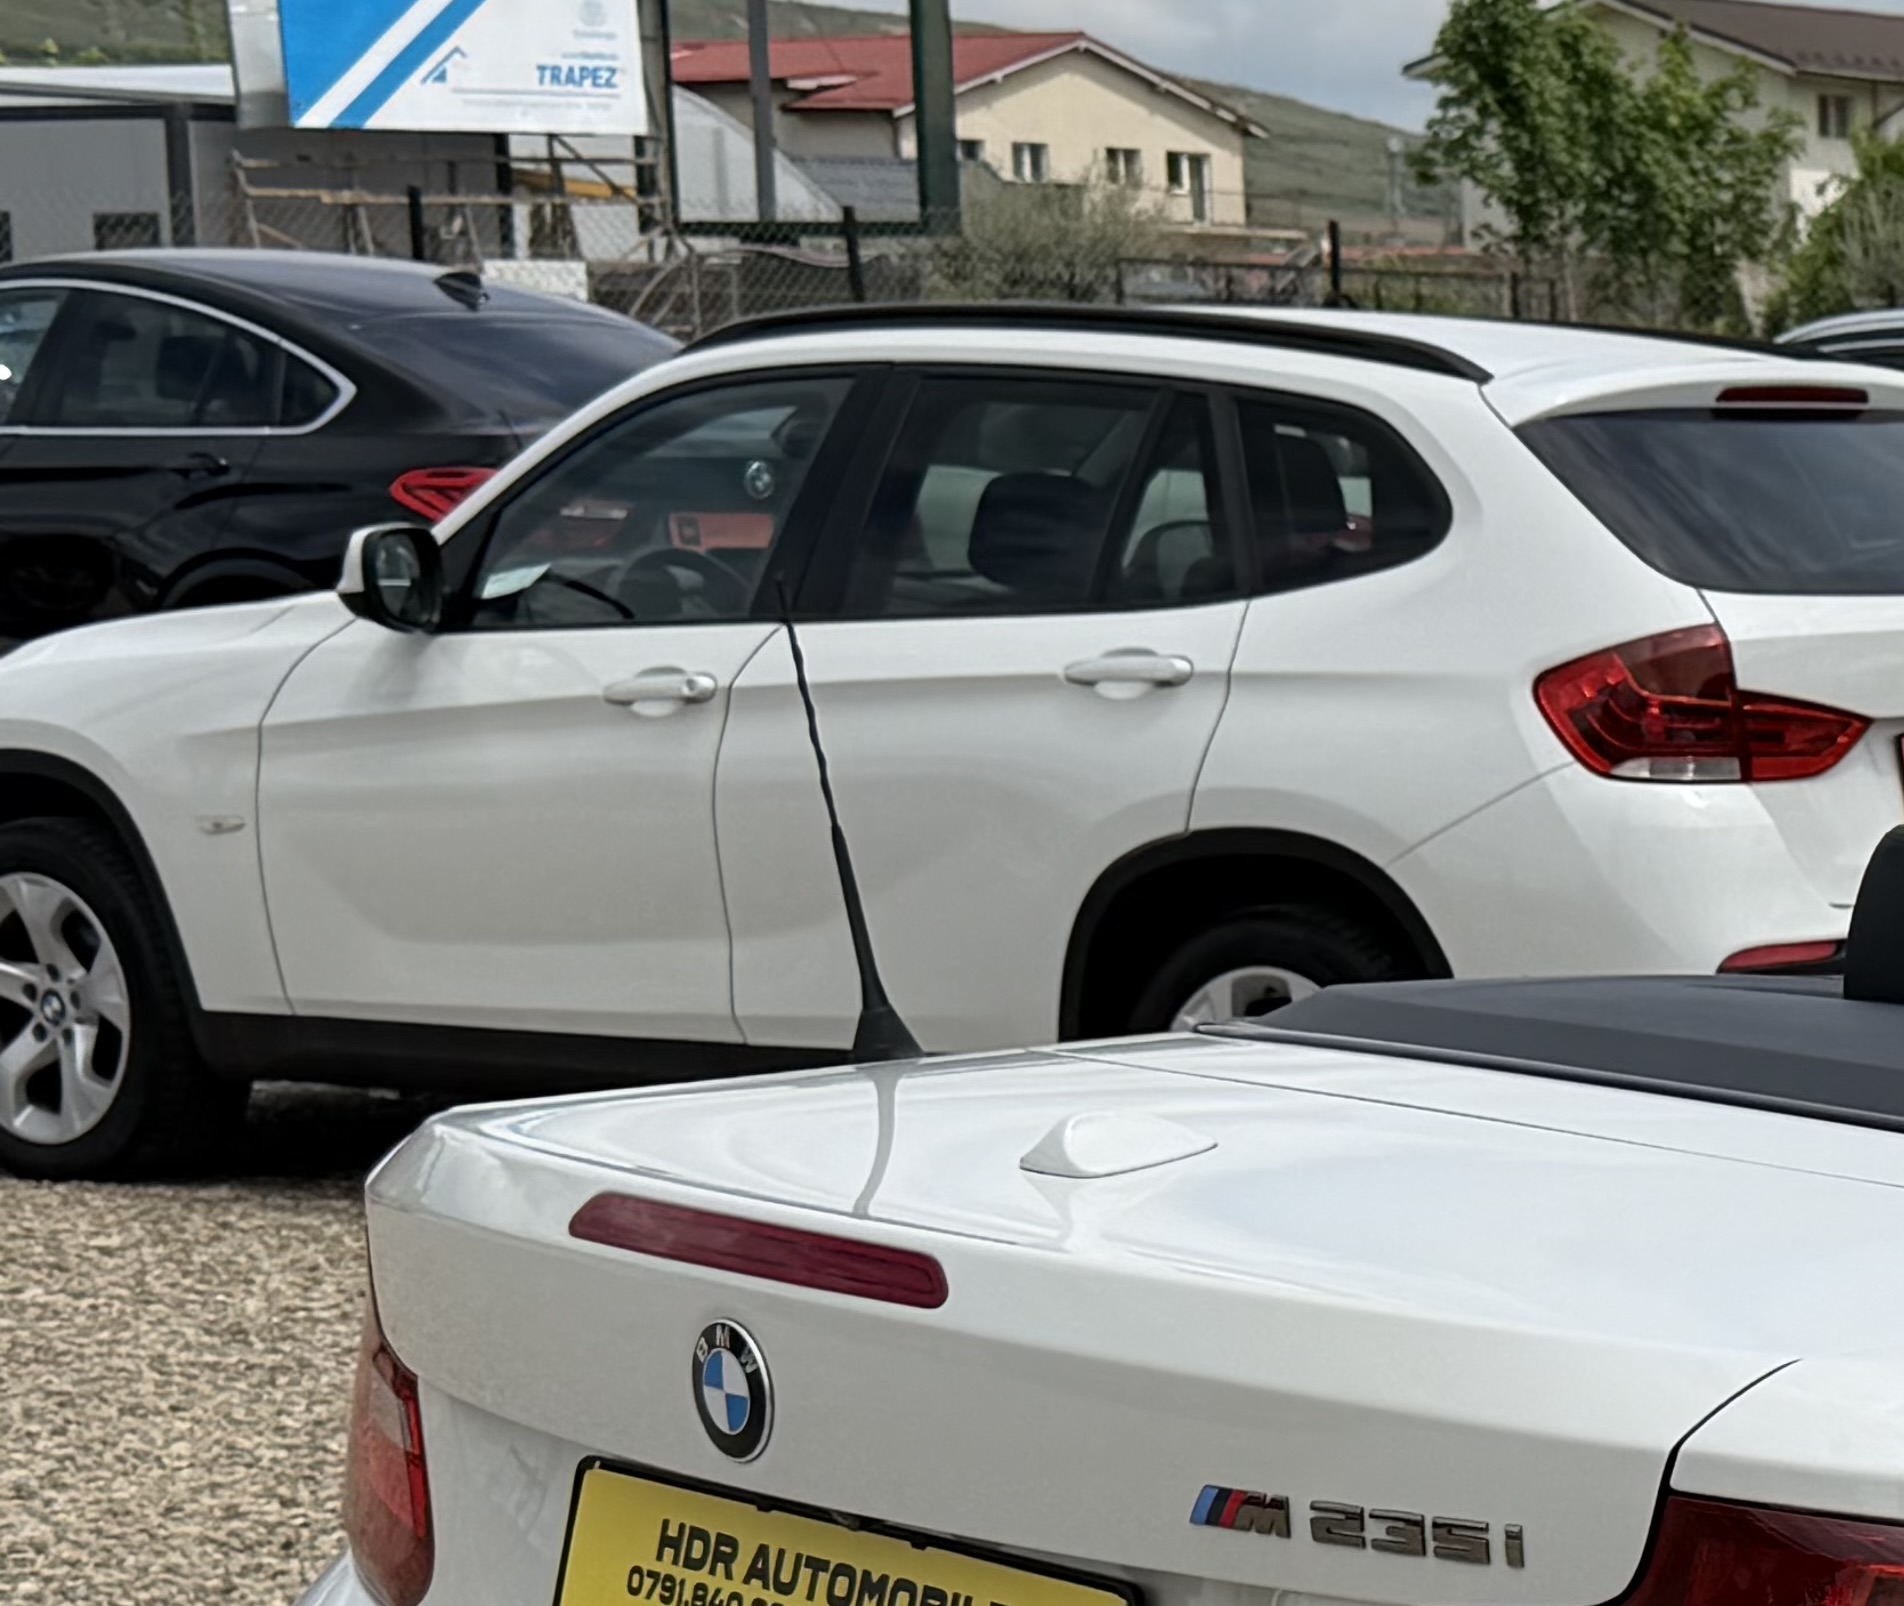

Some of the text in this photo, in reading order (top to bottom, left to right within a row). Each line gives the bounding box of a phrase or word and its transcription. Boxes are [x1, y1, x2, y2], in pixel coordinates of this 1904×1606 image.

[536, 64, 618, 89] TRAPEZ
[697, 1324, 760, 1374] BMW
[656, 1518, 740, 1581] HDR
